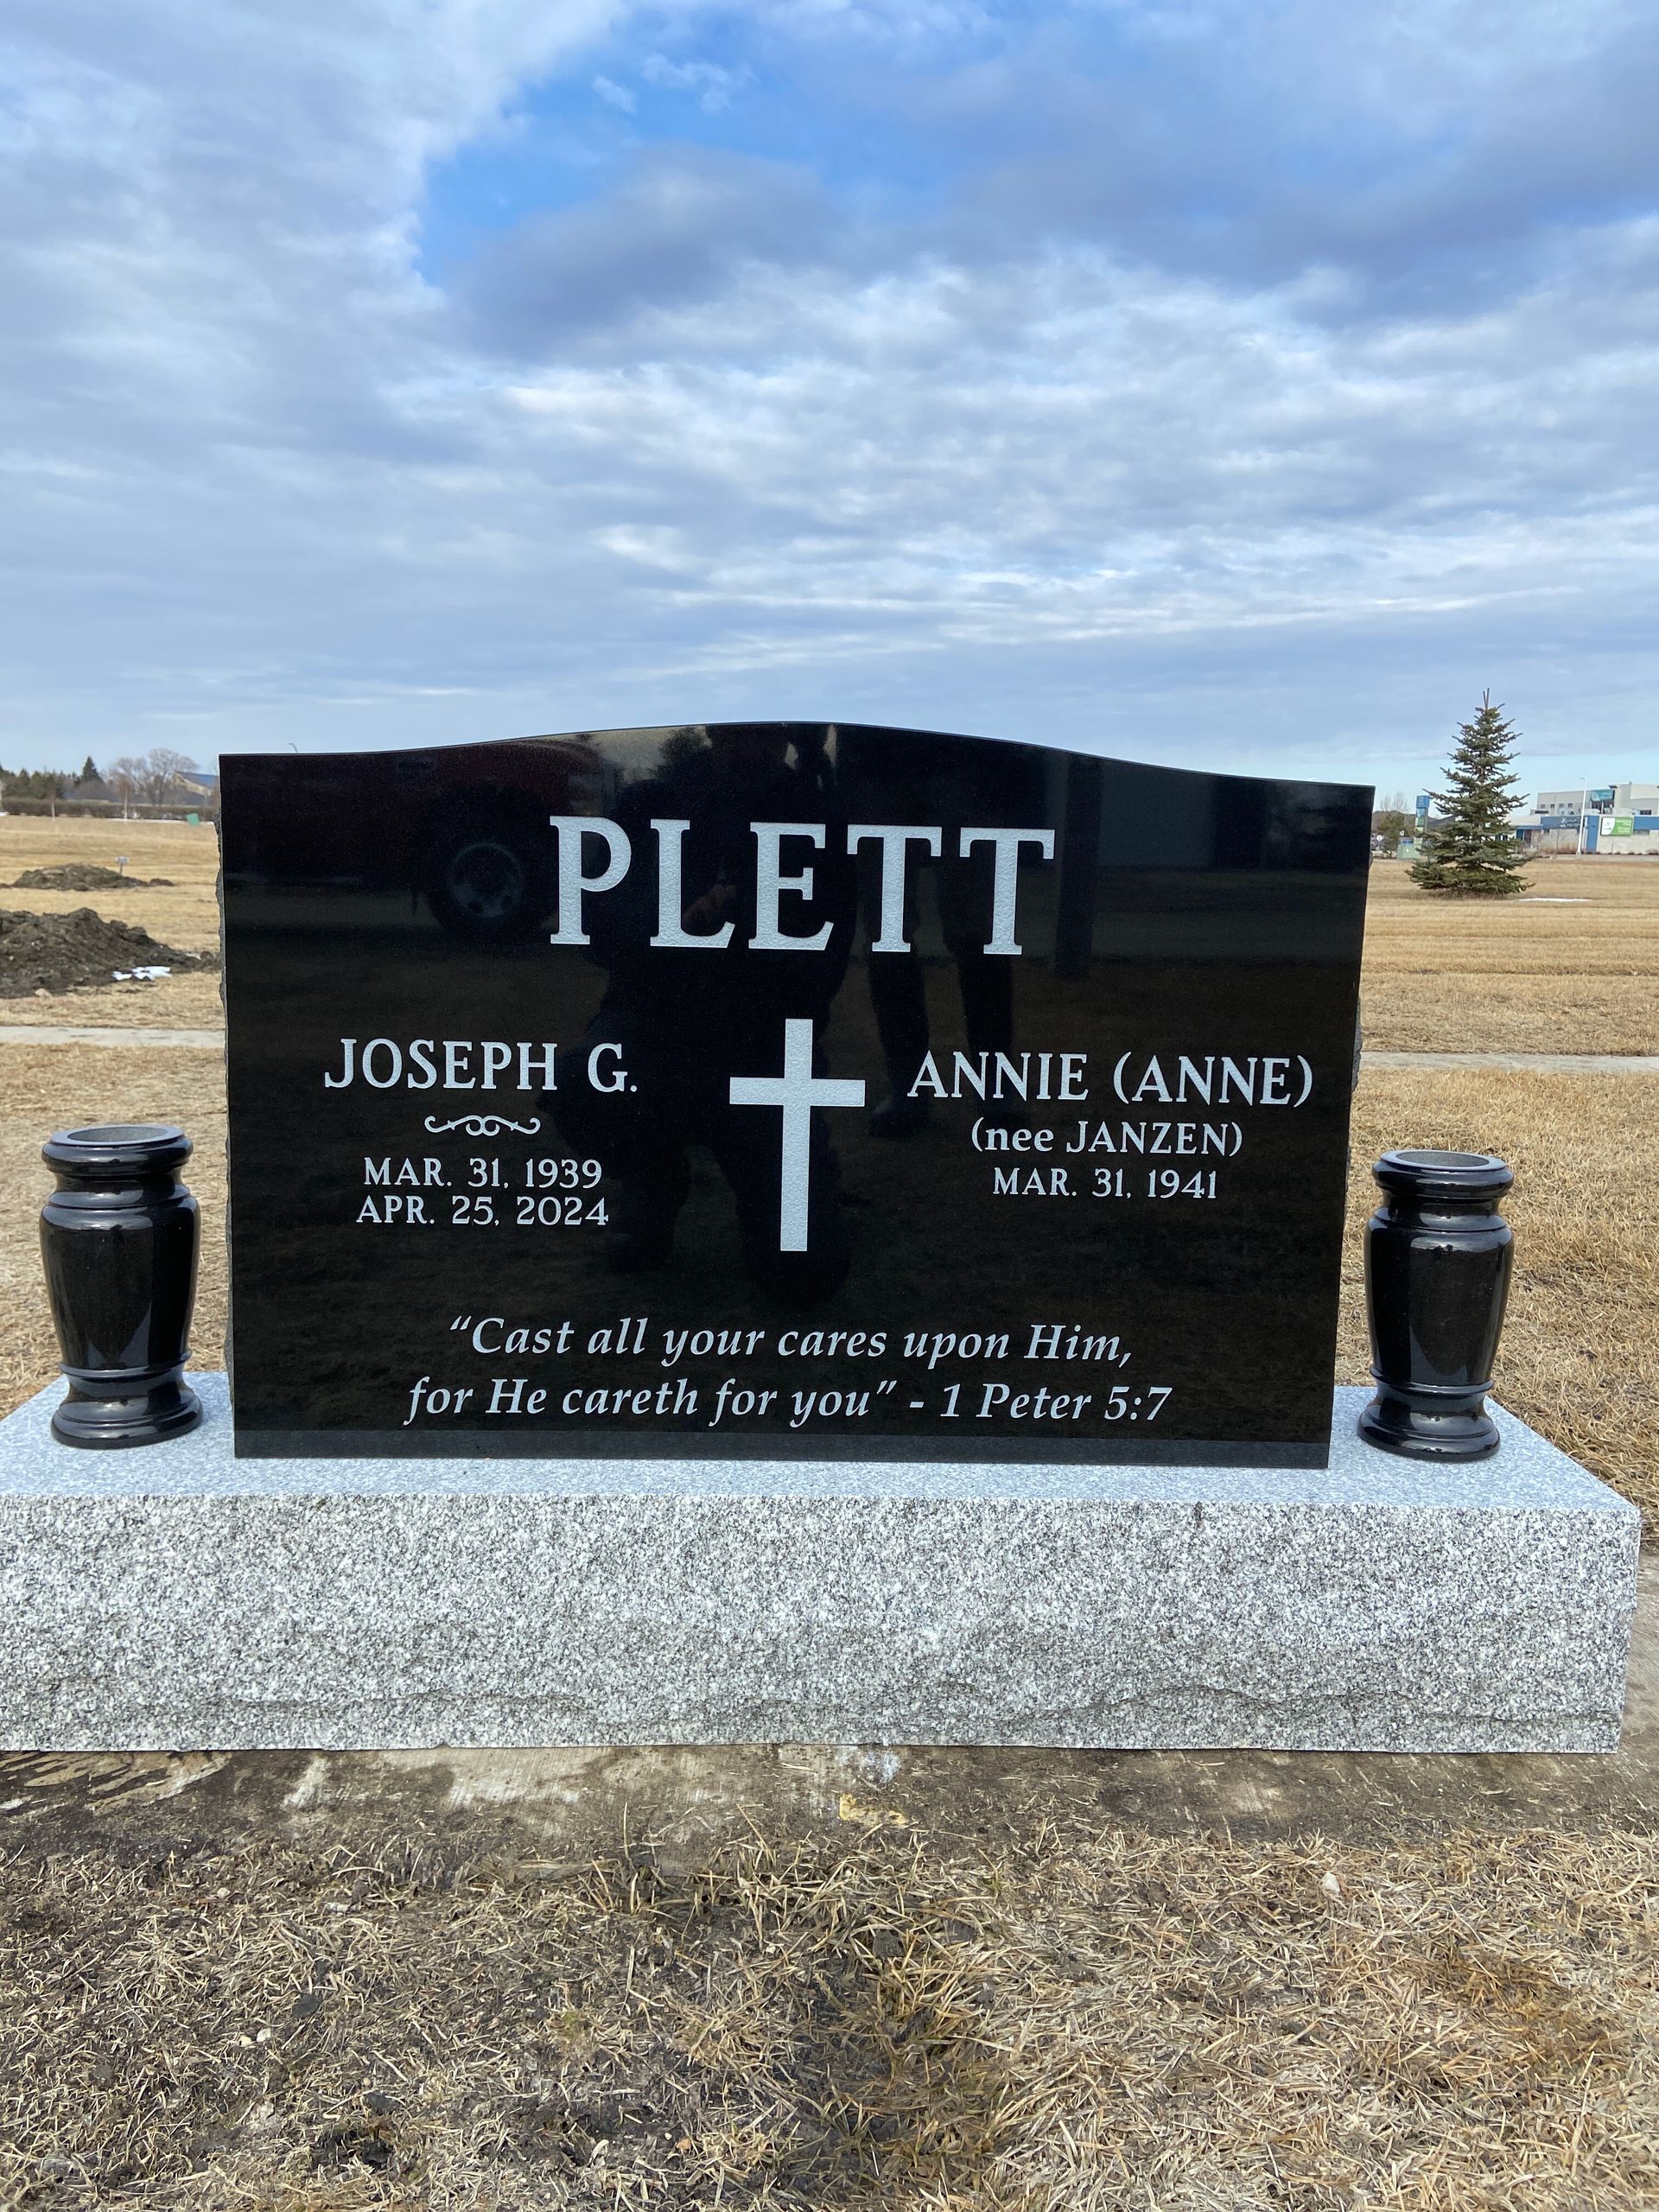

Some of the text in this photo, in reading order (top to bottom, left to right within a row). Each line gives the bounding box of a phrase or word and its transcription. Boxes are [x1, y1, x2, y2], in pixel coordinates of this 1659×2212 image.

[549, 815, 1056, 956] PLETT
[324, 1038, 639, 1093] JOSEPH G.
[906, 1050, 1313, 1108] ANNIE (ANNE)
[971, 1116, 1243, 1157] (nee JANZEN)
[364, 1156, 602, 1189] MAR. 31, 1939
[992, 1166, 1217, 1199] MAR. 31, 1941
[355, 1195, 609, 1226] APR. 25, 2024
[449, 1315, 1132, 1370] “Cast all your cares upon Him,
[403, 1376, 474, 1426] for
[485, 1378, 547, 1414] He
[562, 1378, 698, 1415] careth
[708, 1377, 778, 1427] for
[789, 1380, 898, 1428] you”
[939, 1383, 961, 1417] 1
[976, 1382, 1092, 1421] Peter
[1103, 1386, 1173, 1421] 5:7
